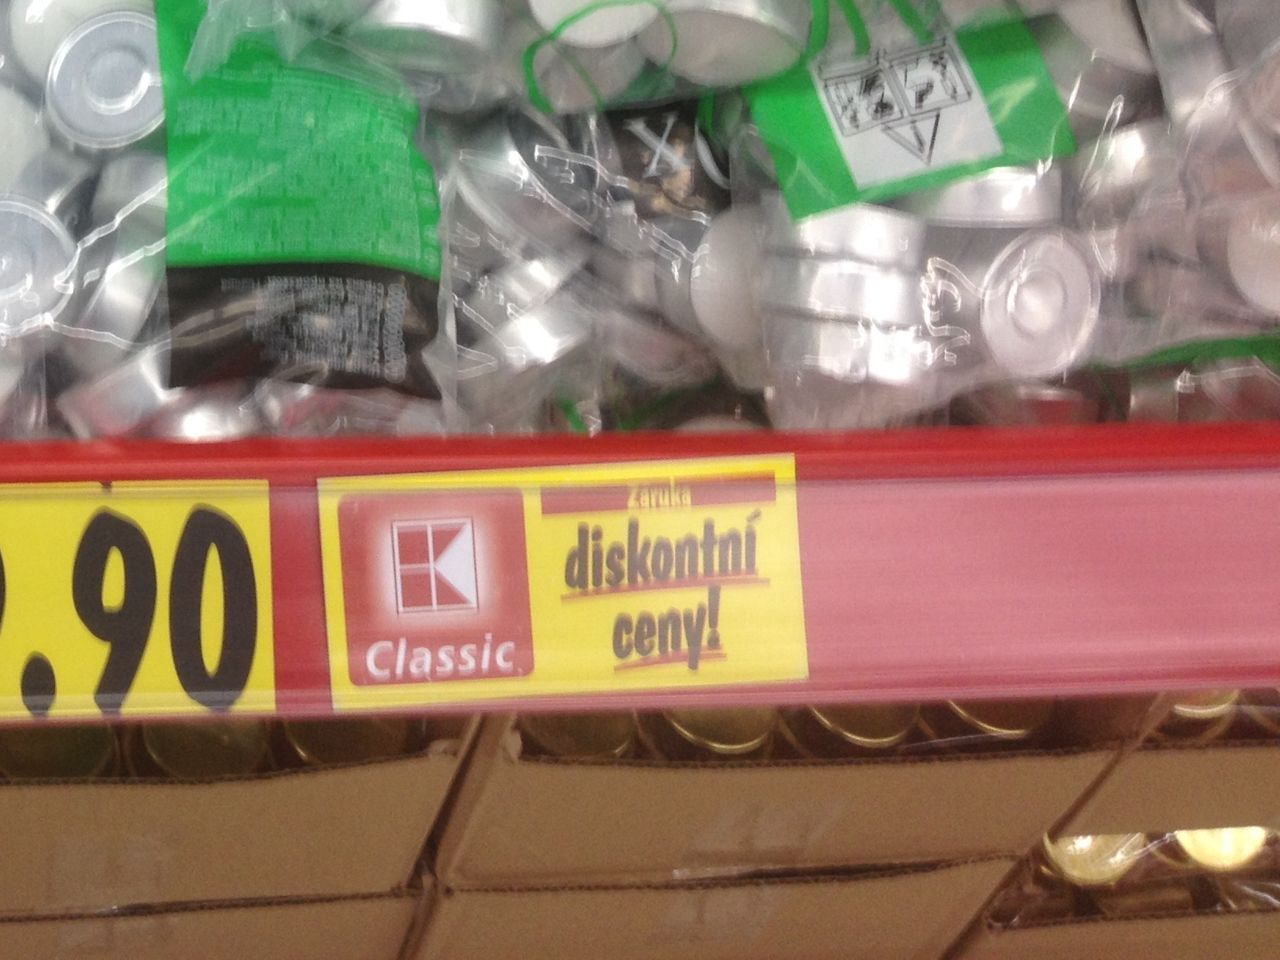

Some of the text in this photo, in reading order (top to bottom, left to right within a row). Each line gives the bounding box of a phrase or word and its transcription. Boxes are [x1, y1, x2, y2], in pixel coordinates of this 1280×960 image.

[564, 509, 763, 592] diskontní
[365, 633, 517, 680] Classic
[612, 586, 722, 672] ceny!
